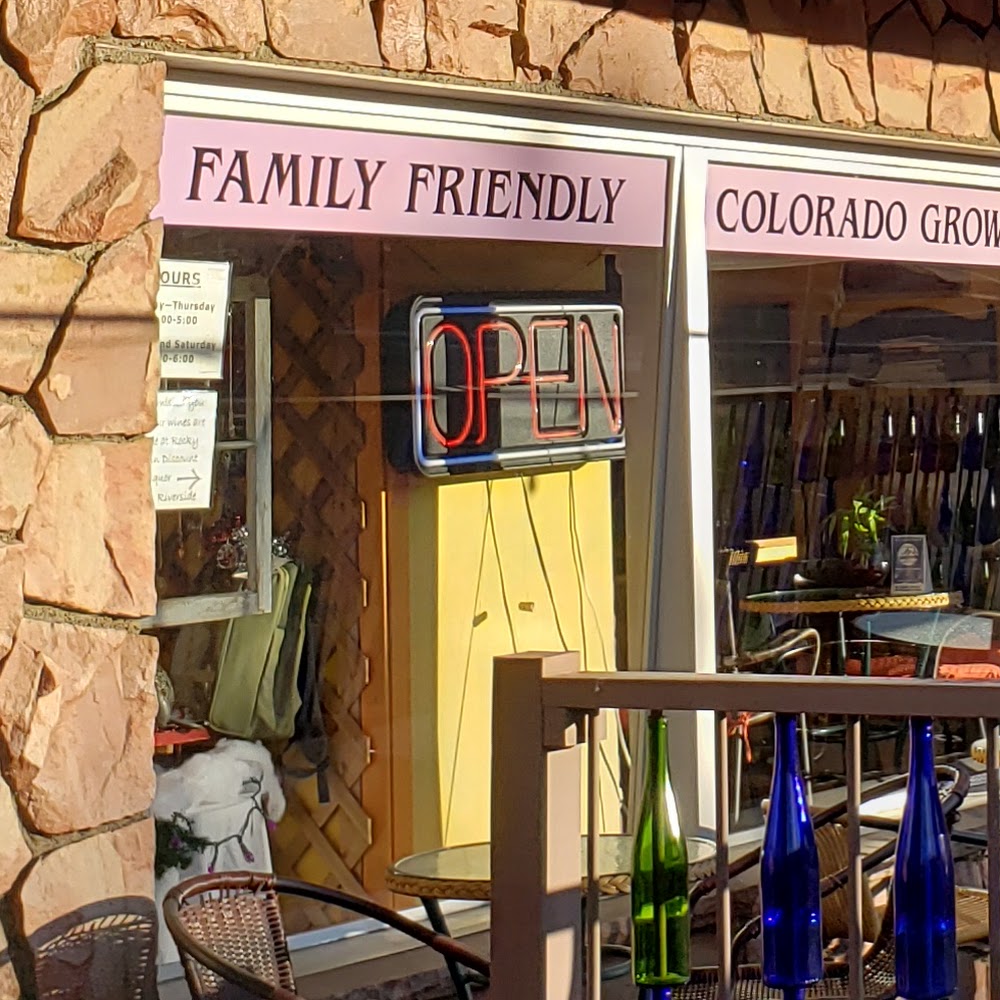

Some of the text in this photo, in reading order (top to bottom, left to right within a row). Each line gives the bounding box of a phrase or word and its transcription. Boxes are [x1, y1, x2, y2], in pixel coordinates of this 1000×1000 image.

[186, 145, 627, 225] FAMILY FRIENDLY
[716, 188, 908, 242] COLORADO
[160, 270, 201, 286] OURS
[161, 314, 198, 325] 00-5:00
[160, 339, 216, 351] nd Saturday
[162, 353, 195, 364] 0-6:00
[423, 317, 623, 449] OPEN
[157, 490, 197, 503] Riverside
